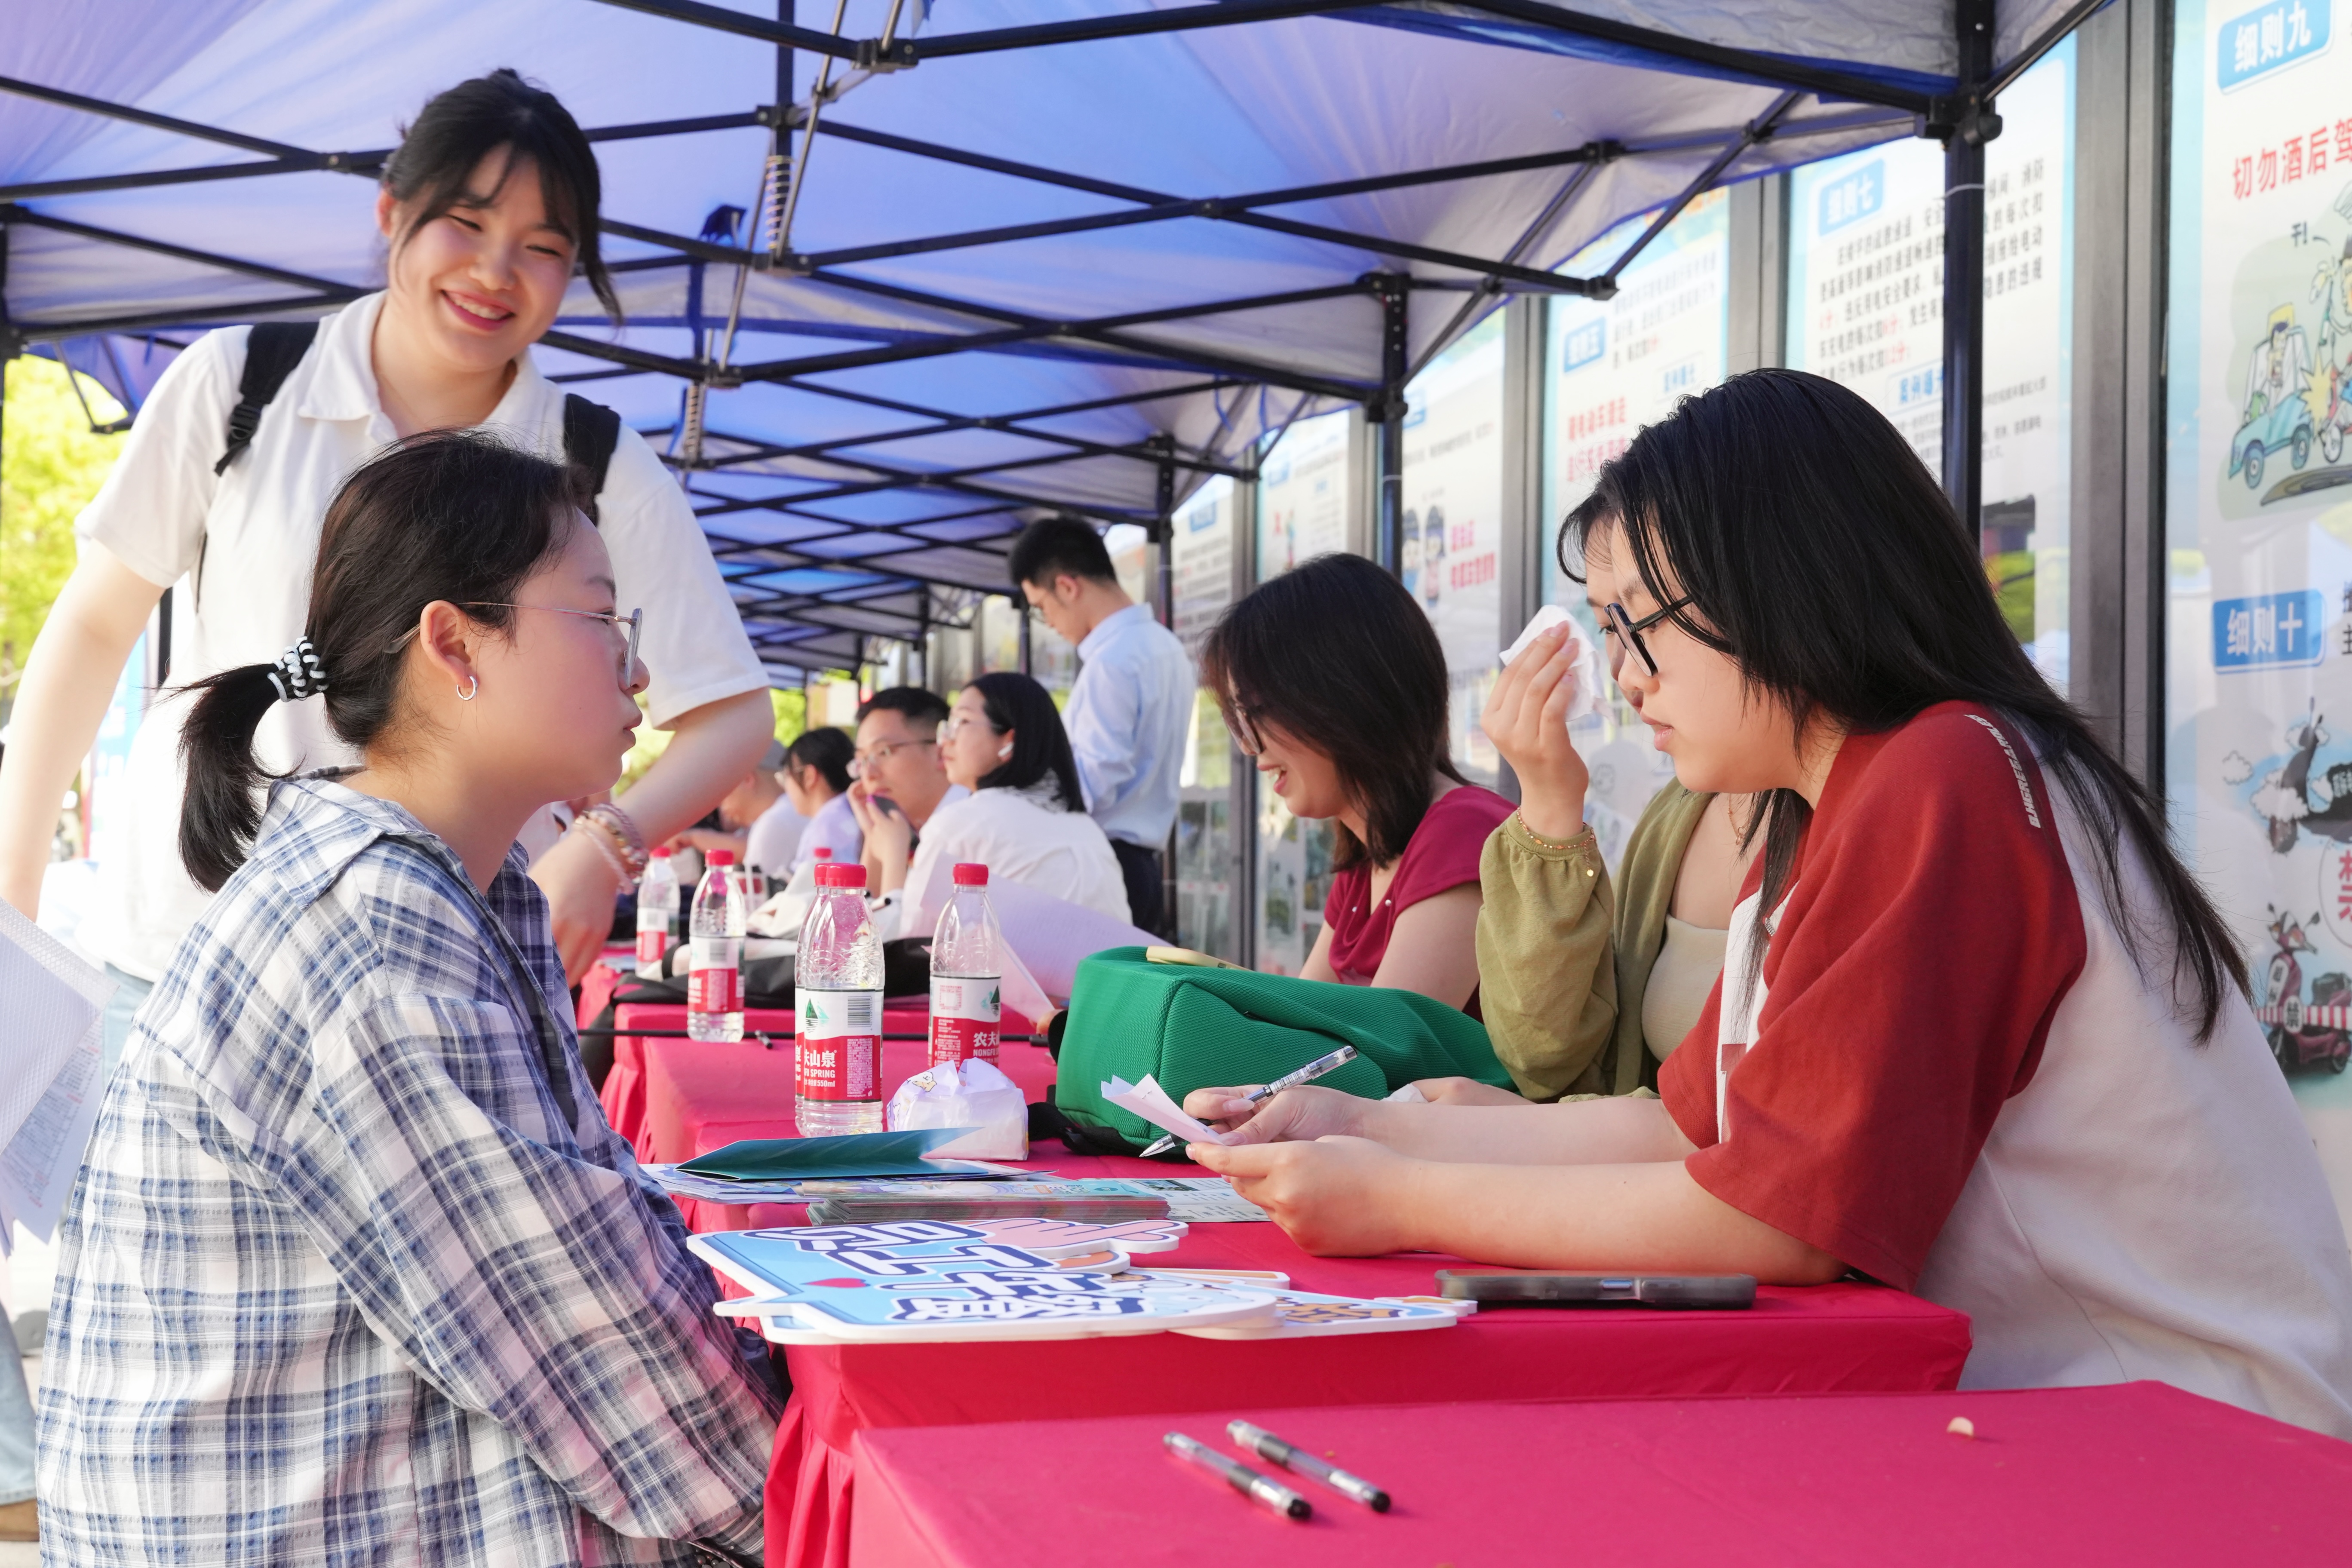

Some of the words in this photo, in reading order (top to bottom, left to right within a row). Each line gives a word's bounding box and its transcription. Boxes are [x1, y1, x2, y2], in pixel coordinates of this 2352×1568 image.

[2234, 0, 2312, 72] 细则九
[2227, 601, 2303, 656] 细则十
[810, 1069, 835, 1078] SPRING
[749, 1221, 1137, 1319] 员工午餐
